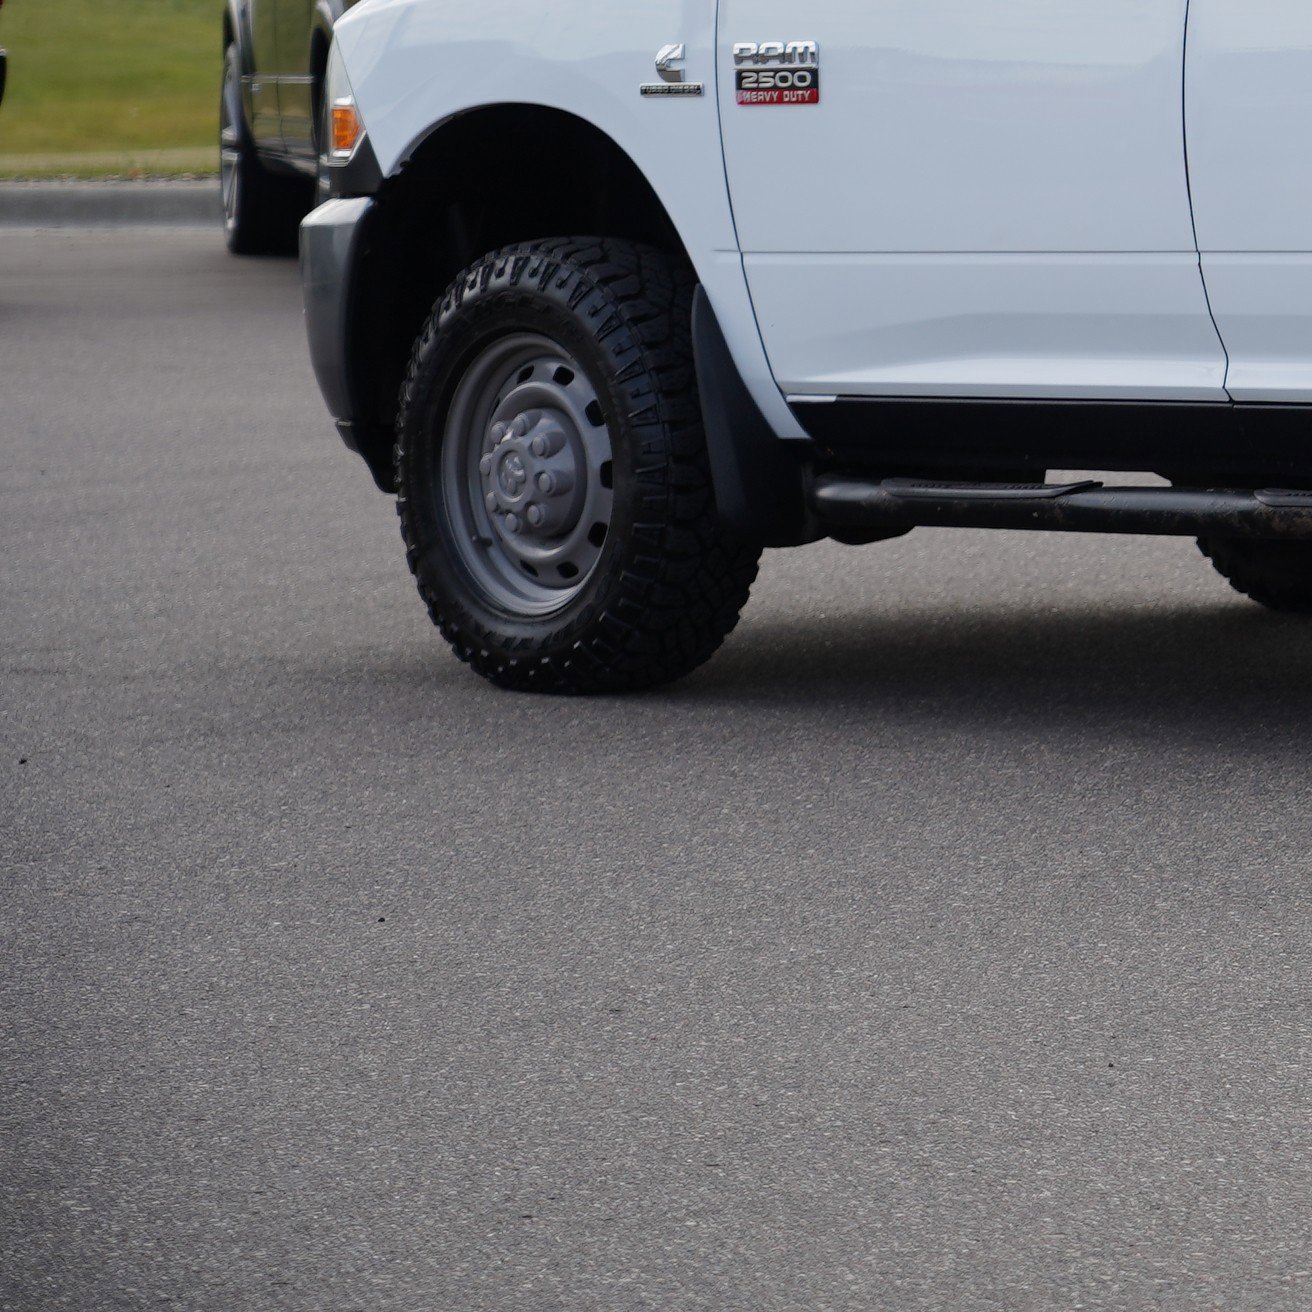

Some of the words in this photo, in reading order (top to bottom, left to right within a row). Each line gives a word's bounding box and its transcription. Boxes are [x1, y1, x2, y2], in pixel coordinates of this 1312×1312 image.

[733, 40, 818, 65] RAM
[740, 71, 812, 88] 2500
[741, 90, 779, 102] HEAVY
[783, 89, 811, 101] DUTY
